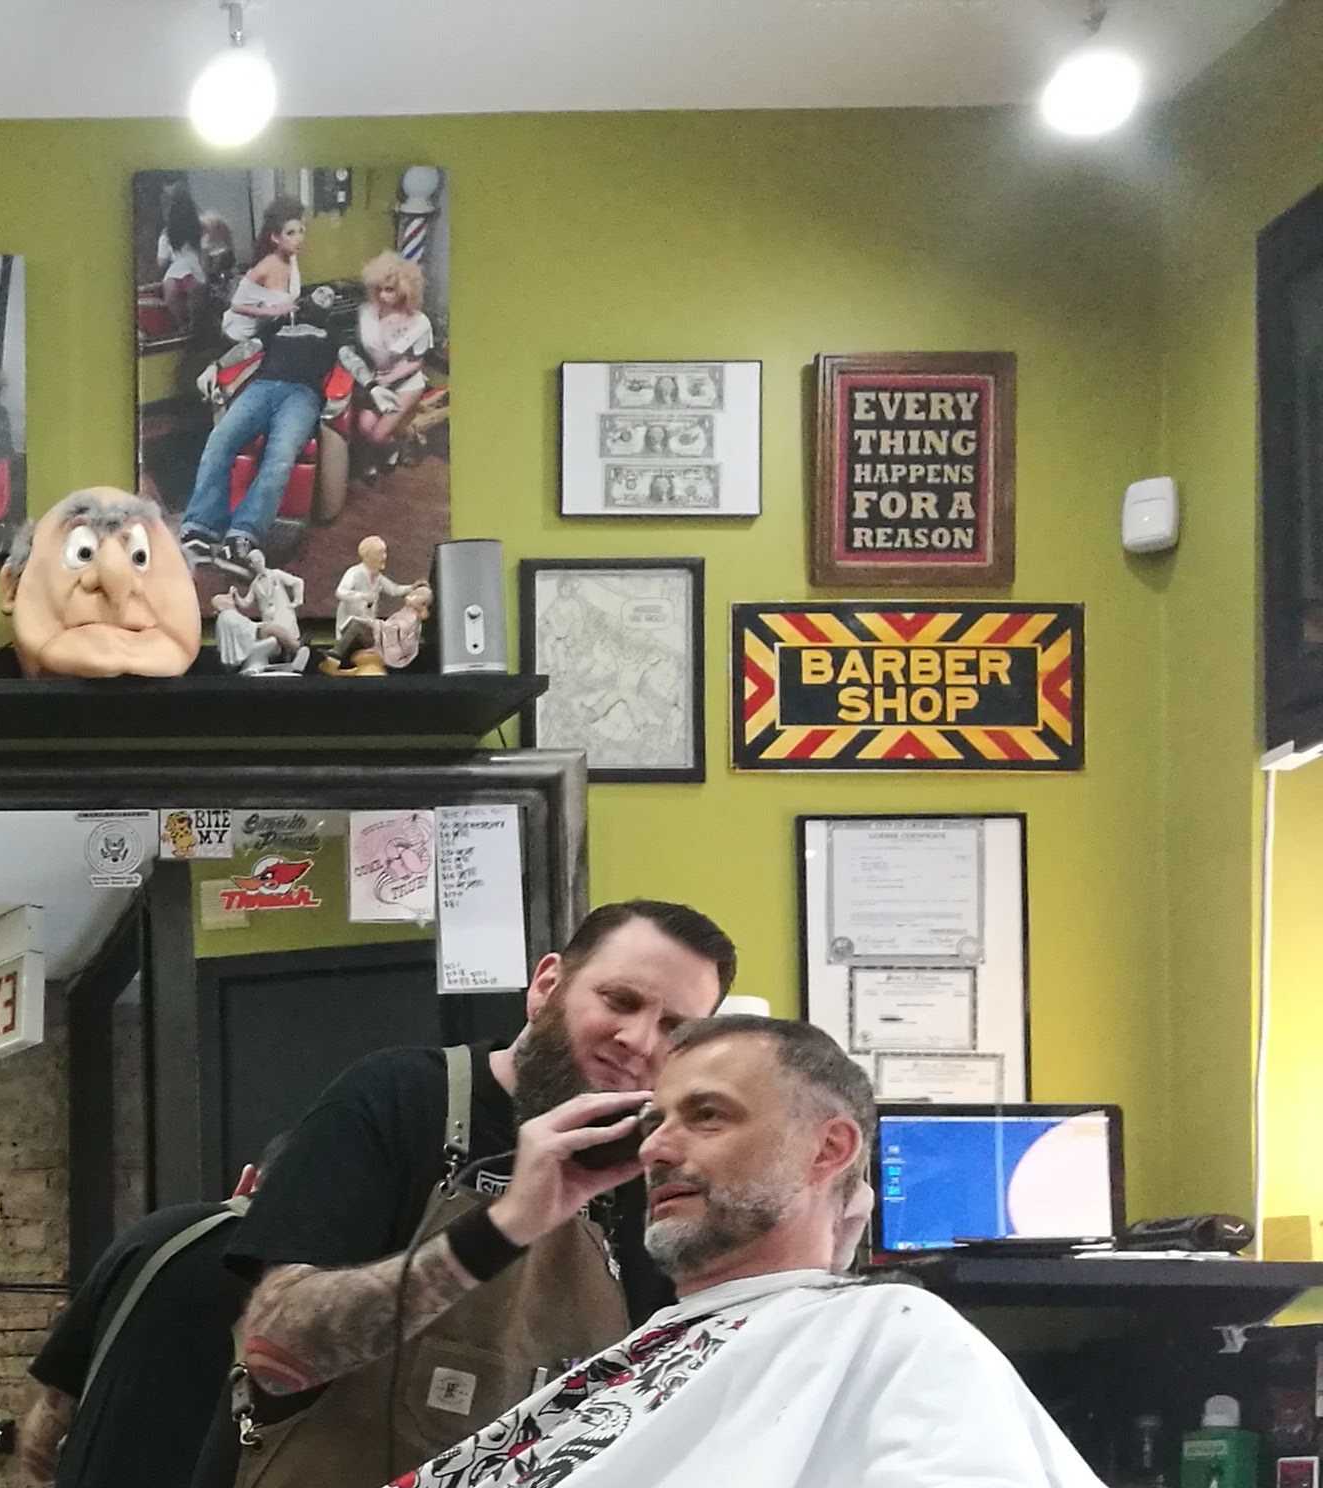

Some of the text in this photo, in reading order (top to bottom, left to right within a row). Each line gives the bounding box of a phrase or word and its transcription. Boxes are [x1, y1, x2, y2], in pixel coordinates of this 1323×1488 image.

[854, 392, 979, 421] EVERY
[854, 429, 976, 456] THING
[854, 463, 974, 484] HAPPENS
[853, 491, 975, 519] FOR A
[853, 527, 974, 549] REASON
[801, 649, 1012, 685] BARBER
[837, 686, 979, 723] SHOP
[195, 810, 231, 829] BITE
[198, 830, 227, 845] MY
